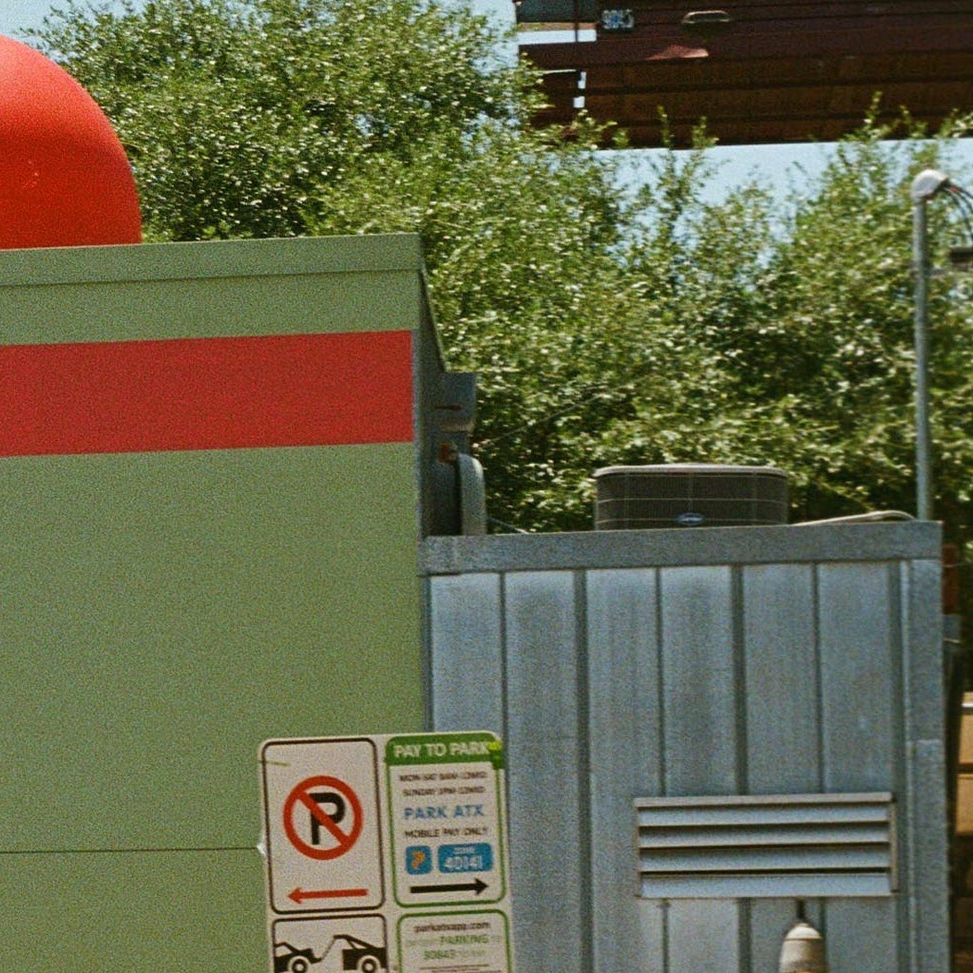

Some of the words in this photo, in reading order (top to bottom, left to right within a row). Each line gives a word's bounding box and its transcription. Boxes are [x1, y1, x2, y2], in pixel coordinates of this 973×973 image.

[393, 744, 422, 759] PAY
[426, 742, 447, 757] TO
[448, 741, 491, 756] PARK
[404, 806, 447, 820] PARK
[453, 804, 484, 818] ATX
[404, 828, 440, 839] MOBILE
[463, 826, 489, 836] ONLY
